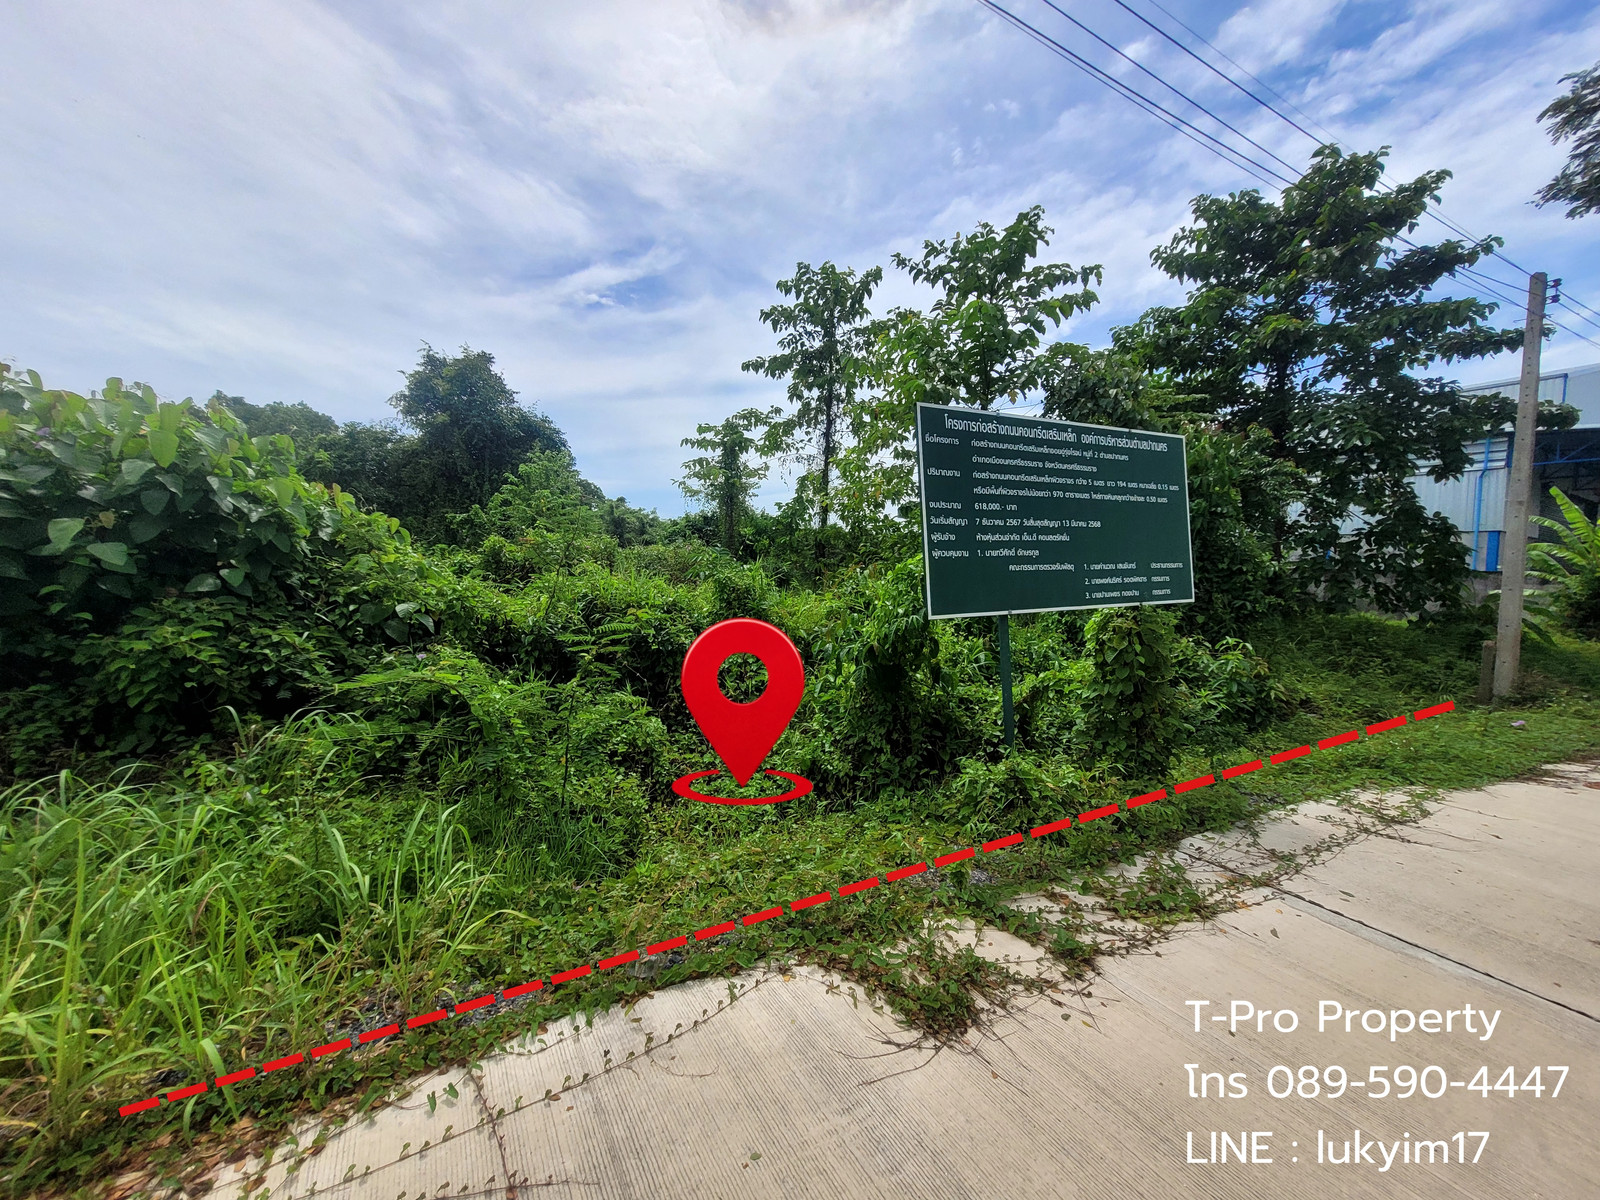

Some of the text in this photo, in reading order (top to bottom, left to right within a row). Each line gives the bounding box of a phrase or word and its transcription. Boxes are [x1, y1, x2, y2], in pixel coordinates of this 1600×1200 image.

[945, 413, 1168, 452] โครงการก่อสร้างถนนคอนกรีตเสริมเหล็ก องค์การบริหารส่วนตำบลปากนคร
[927, 467, 960, 477] ปริมาณงาน
[929, 500, 961, 509] งบประมาณ
[1006, 518, 1020, 526] 2567
[1088, 520, 1101, 528] 2568
